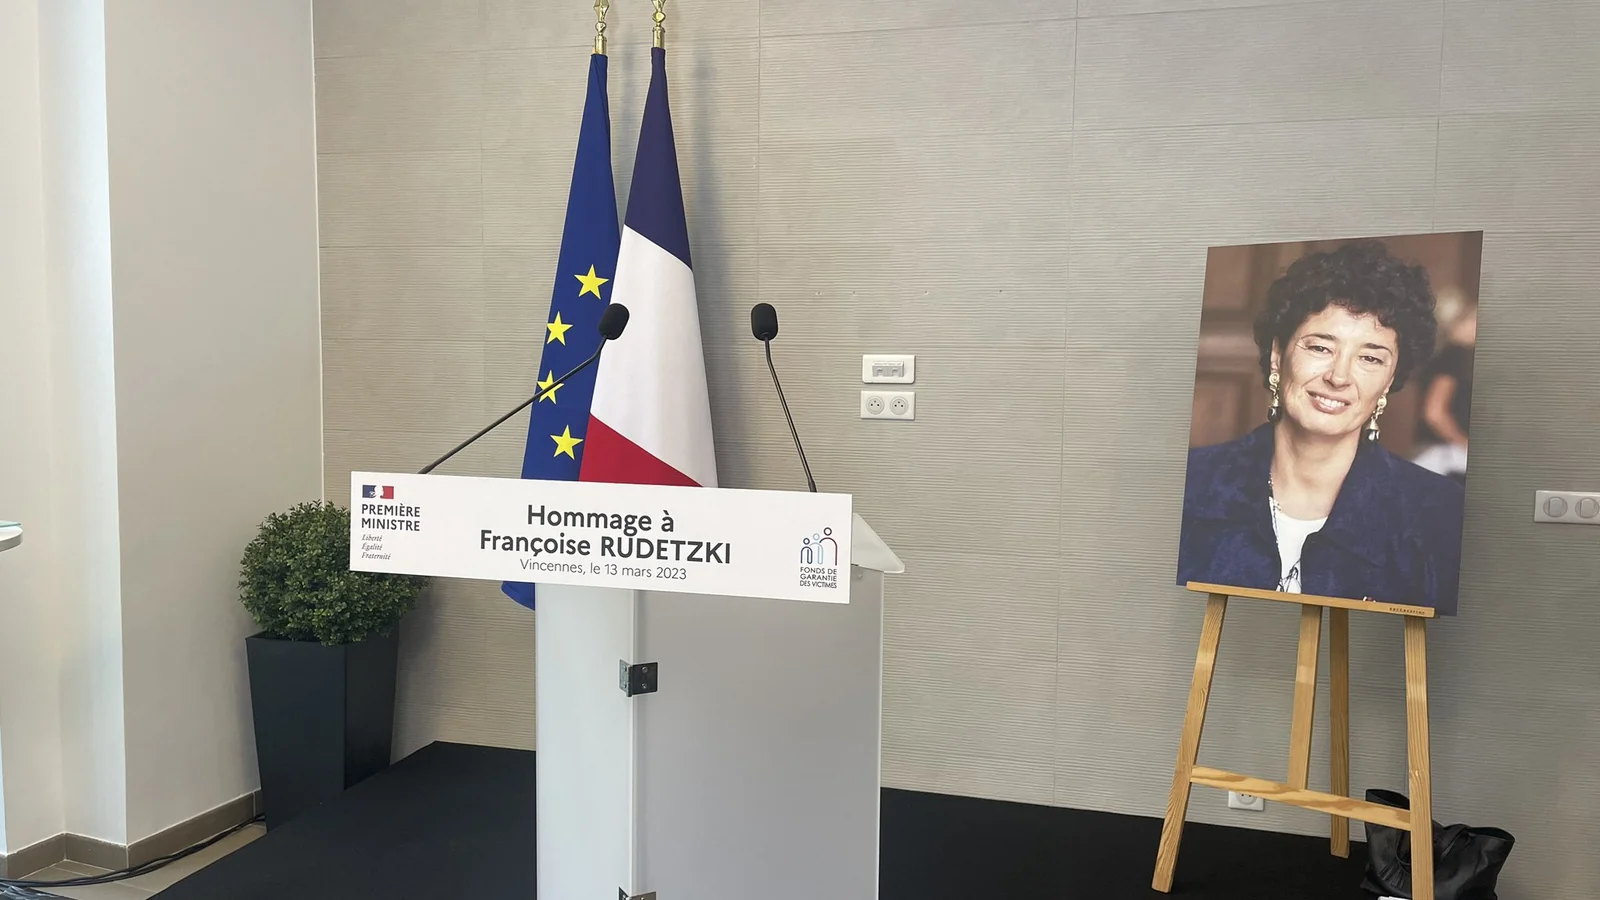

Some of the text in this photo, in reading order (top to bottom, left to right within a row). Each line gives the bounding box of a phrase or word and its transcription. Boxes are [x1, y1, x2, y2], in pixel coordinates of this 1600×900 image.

[361, 503, 421, 518] PREMIÈRE
[361, 517, 421, 532] MINISTRE
[527, 504, 675, 537] Hommage à
[361, 534, 383, 542] Liberté
[361, 542, 383, 551] Égalité
[480, 529, 731, 564] Françoise RUDETZKI
[361, 551, 391, 560] Fraternité
[519, 558, 687, 580] Vincennes, le 13 mars 2023
[800, 566, 826, 575] FONDS
[799, 573, 837, 582] GARANTIE
[811, 580, 838, 589] VICTIMES
